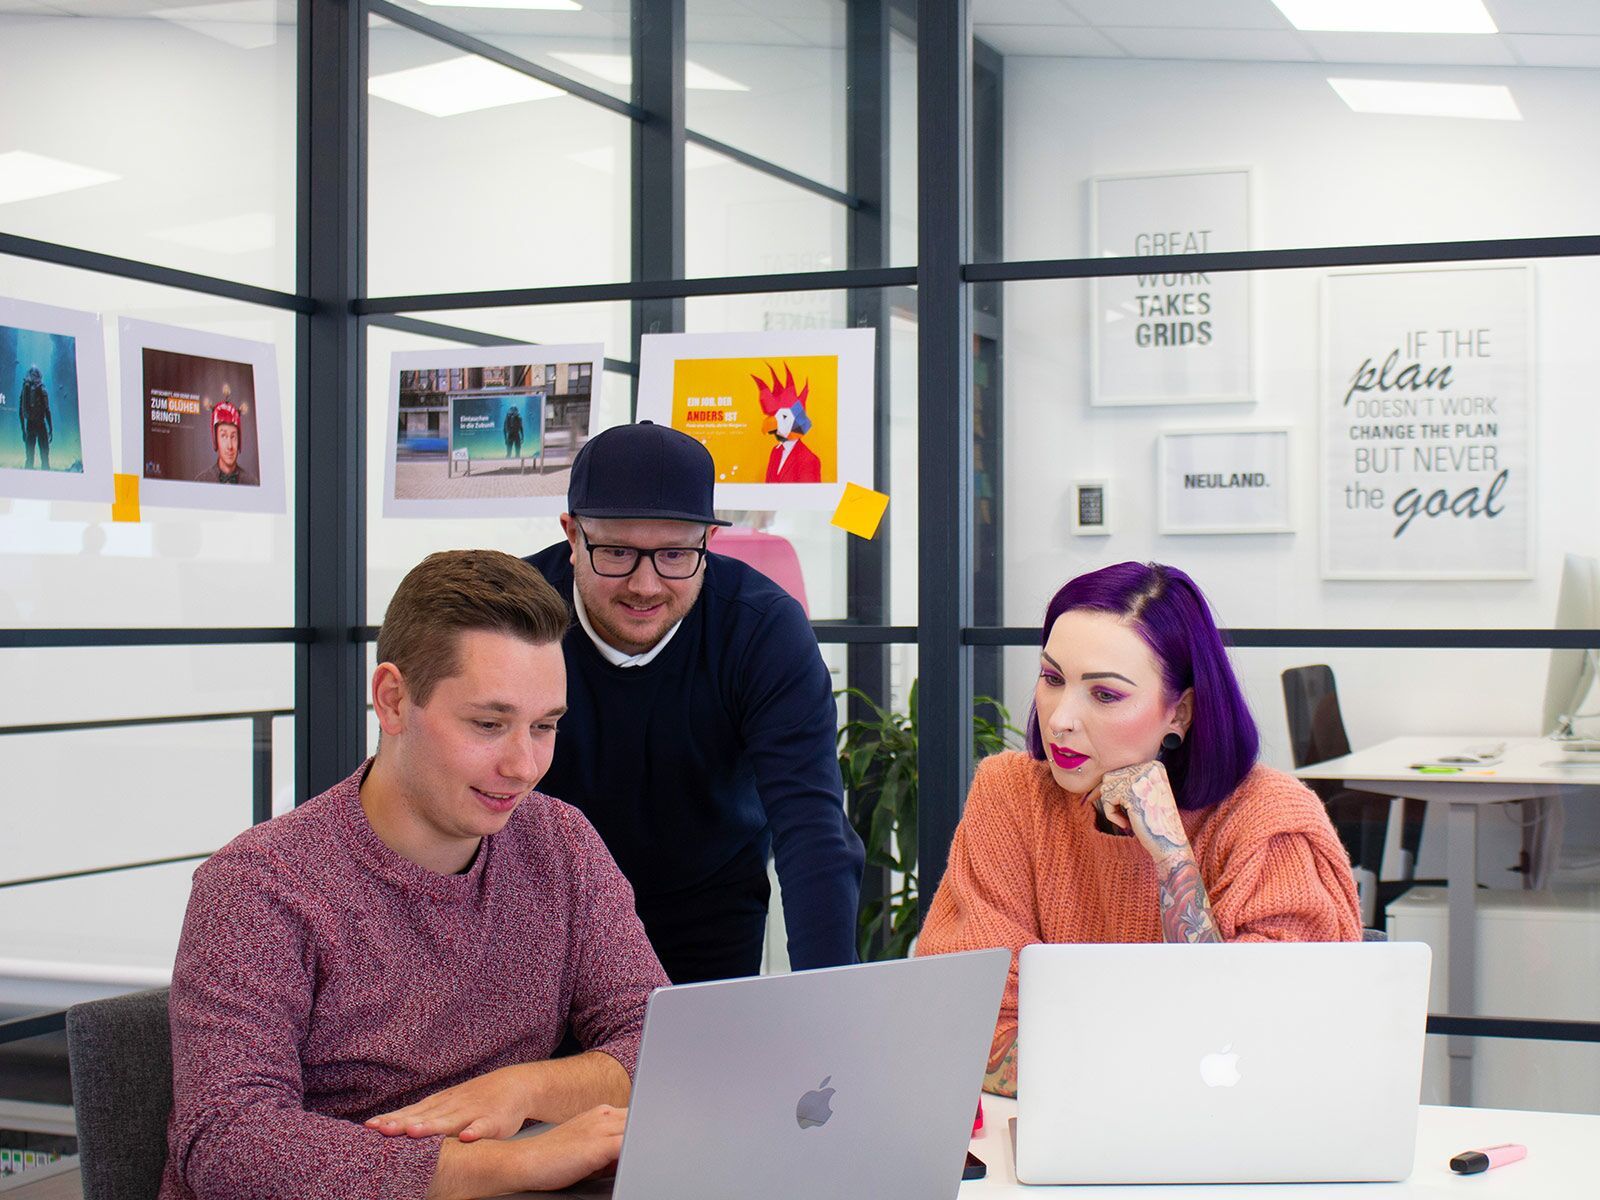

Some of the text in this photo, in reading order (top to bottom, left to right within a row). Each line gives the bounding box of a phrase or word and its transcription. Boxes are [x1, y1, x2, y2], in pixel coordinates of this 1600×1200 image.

[1135, 231, 1212, 257] GREAT
[1135, 292, 1211, 318] TAKES
[1136, 320, 1213, 348] GRIDS
[1406, 329, 1491, 359] IF THE
[1343, 348, 1454, 407] plan
[151, 397, 168, 410] ZUM
[151, 409, 181, 424] BRINGT!
[687, 410, 724, 422] ANDERS
[1440, 397, 1498, 416] WORK
[1350, 423, 1498, 441] CHANGE THE PLAN
[1355, 445, 1499, 473] BUT NEVER
[1184, 473, 1271, 489] NEULAND.
[1344, 469, 1509, 539] the goal
